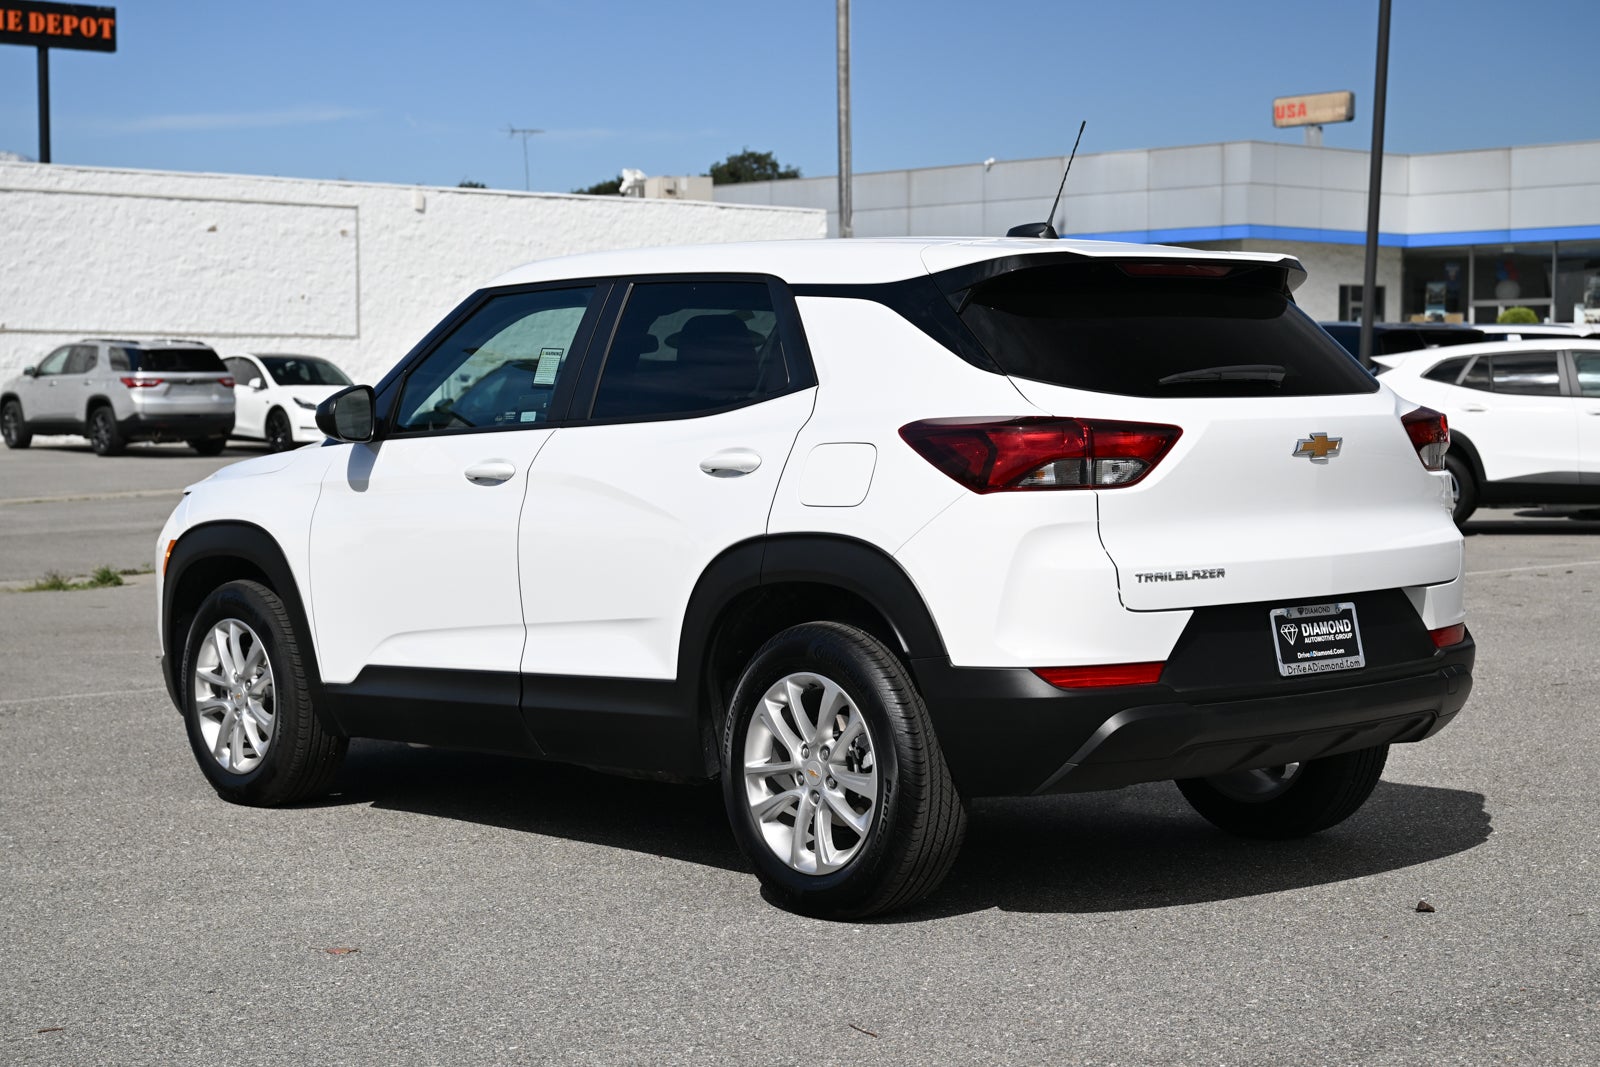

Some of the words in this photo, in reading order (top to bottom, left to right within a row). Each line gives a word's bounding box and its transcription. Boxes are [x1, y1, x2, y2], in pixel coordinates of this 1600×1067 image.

[0, 8, 23, 32] E
[28, 11, 115, 40] DEPOT
[1275, 103, 1307, 119] USA
[1135, 568, 1226, 583] TRAILBLAZER
[1304, 607, 1330, 615] DIAMOND
[1301, 619, 1352, 637] DIAMOND
[1304, 634, 1335, 644] AUTOMOTIVE
[1335, 632, 1353, 641] GROUP
[1297, 648, 1345, 659] DriveADiamond.Com
[1287, 659, 1361, 675] DriveADiamond.Com
